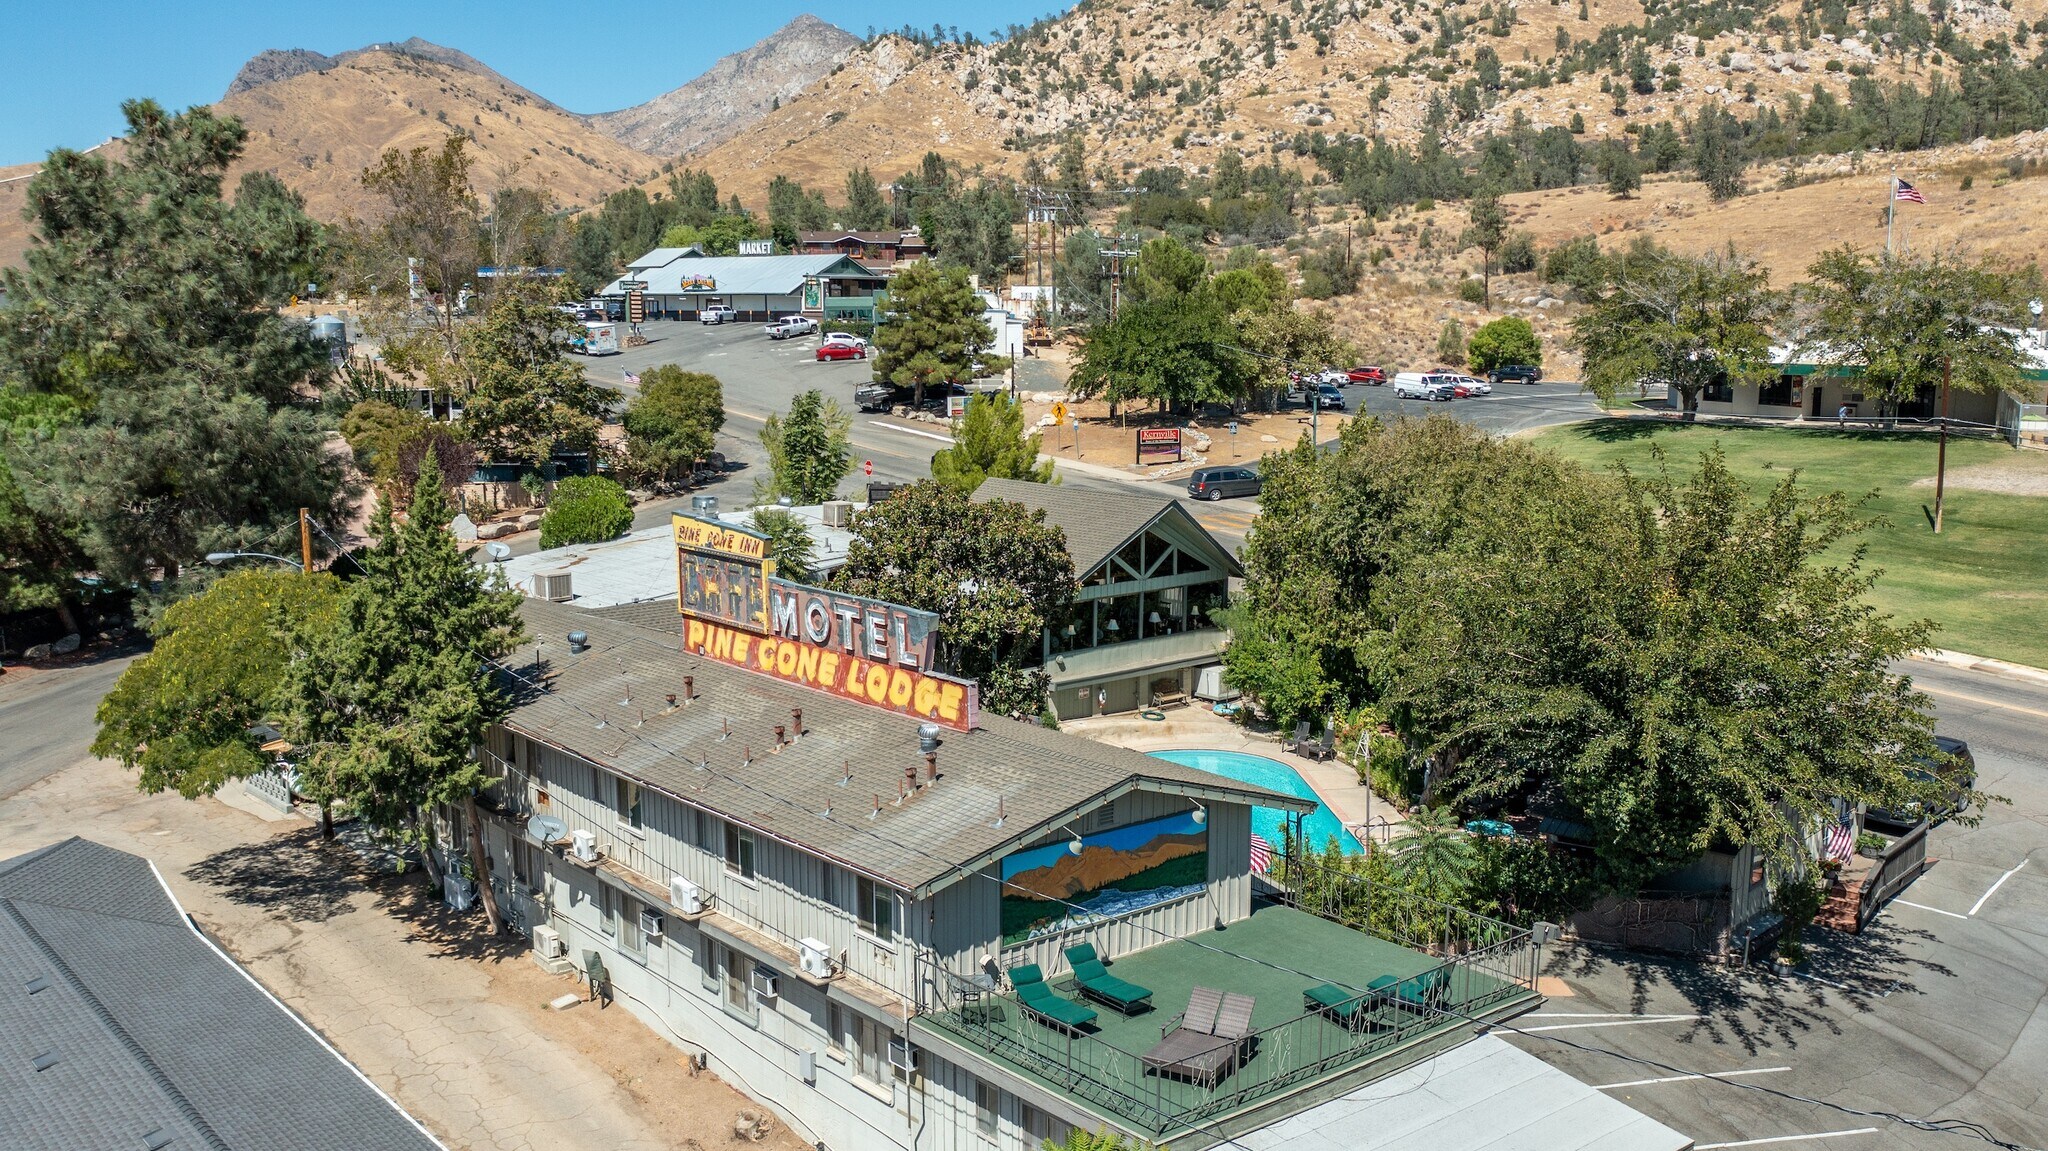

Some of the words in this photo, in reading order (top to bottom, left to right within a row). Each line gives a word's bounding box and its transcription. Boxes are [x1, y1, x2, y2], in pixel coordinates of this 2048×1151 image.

[739, 242, 772, 255] MARKET
[678, 525, 702, 543] PINE
[740, 536, 761, 555] INN
[770, 587, 919, 667] MOTEL
[688, 619, 751, 663] PINE
[758, 636, 840, 687] CONE
[846, 658, 963, 721] LODGE
